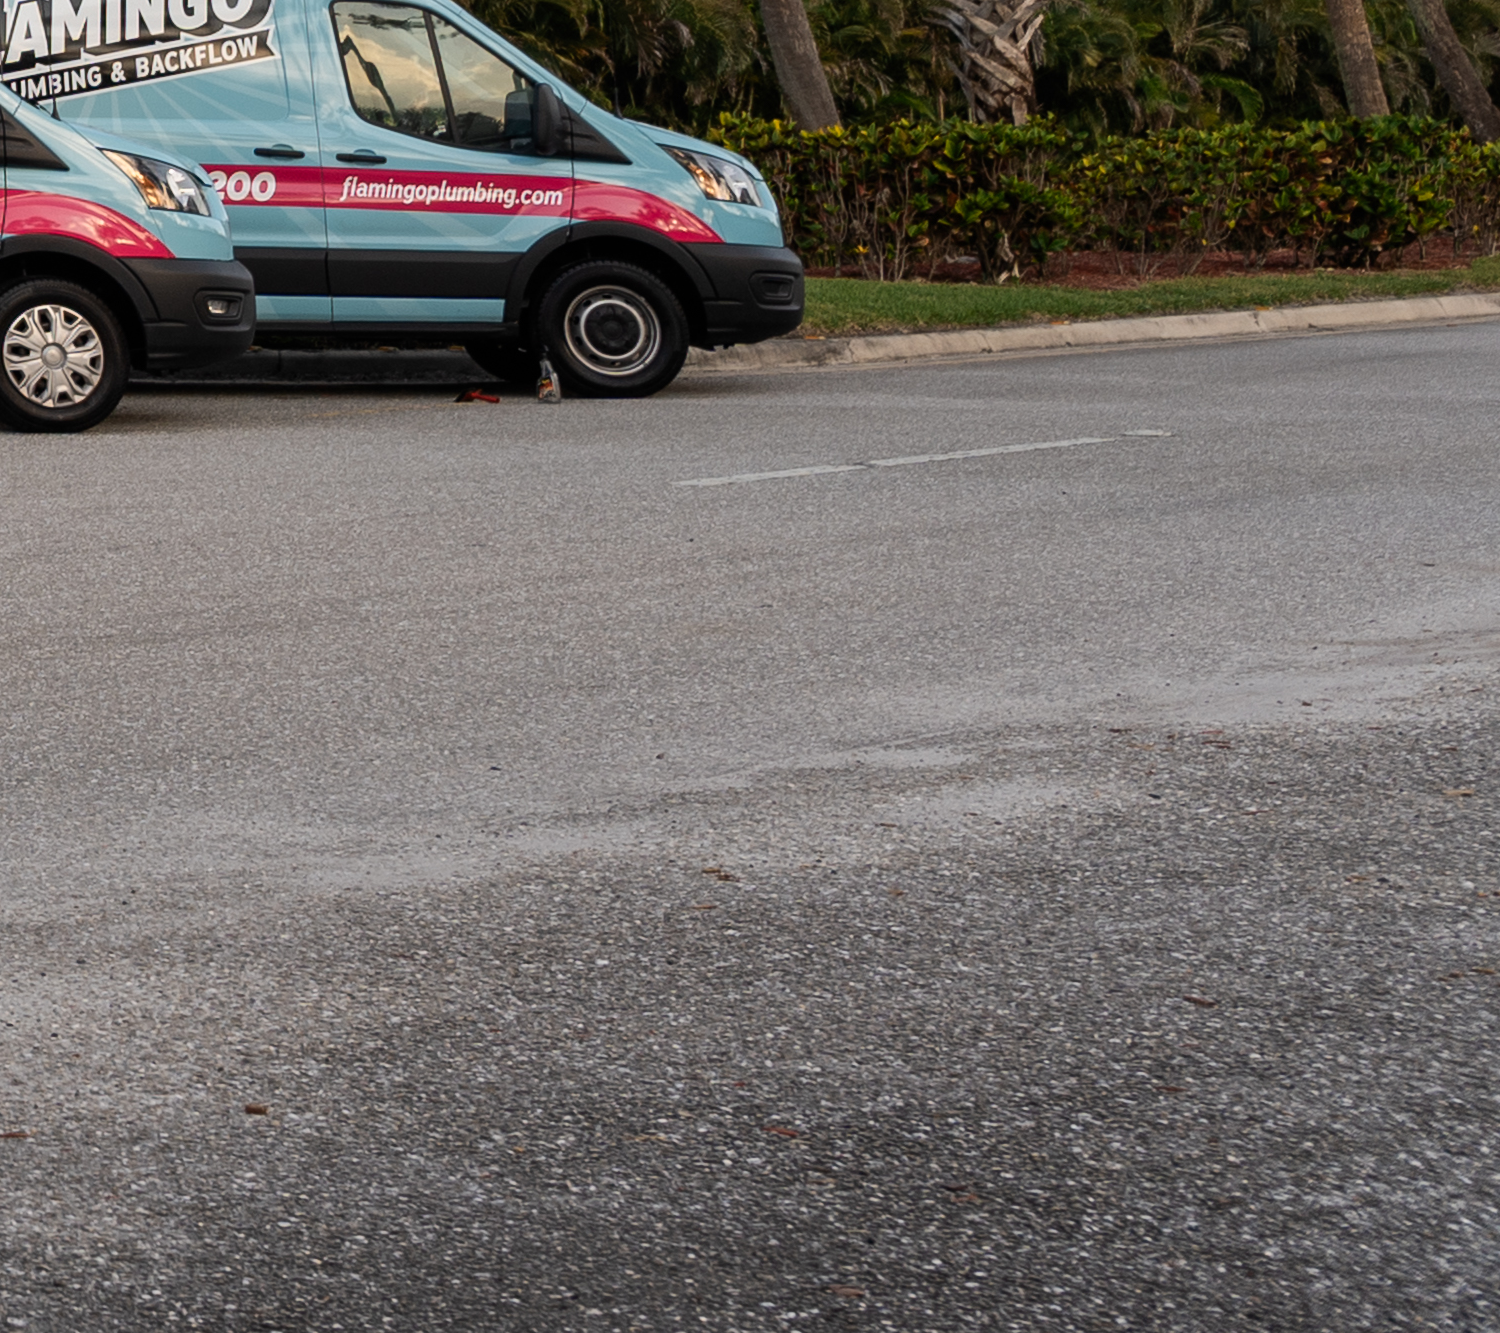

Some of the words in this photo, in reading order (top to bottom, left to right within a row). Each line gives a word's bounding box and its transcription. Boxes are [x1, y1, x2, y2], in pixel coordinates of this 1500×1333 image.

[10, 66, 101, 100] UMBING
[110, 62, 126, 83] &
[135, 35, 258, 79] BACKFLOW
[339, 176, 563, 209] flamingoplumbing.com
